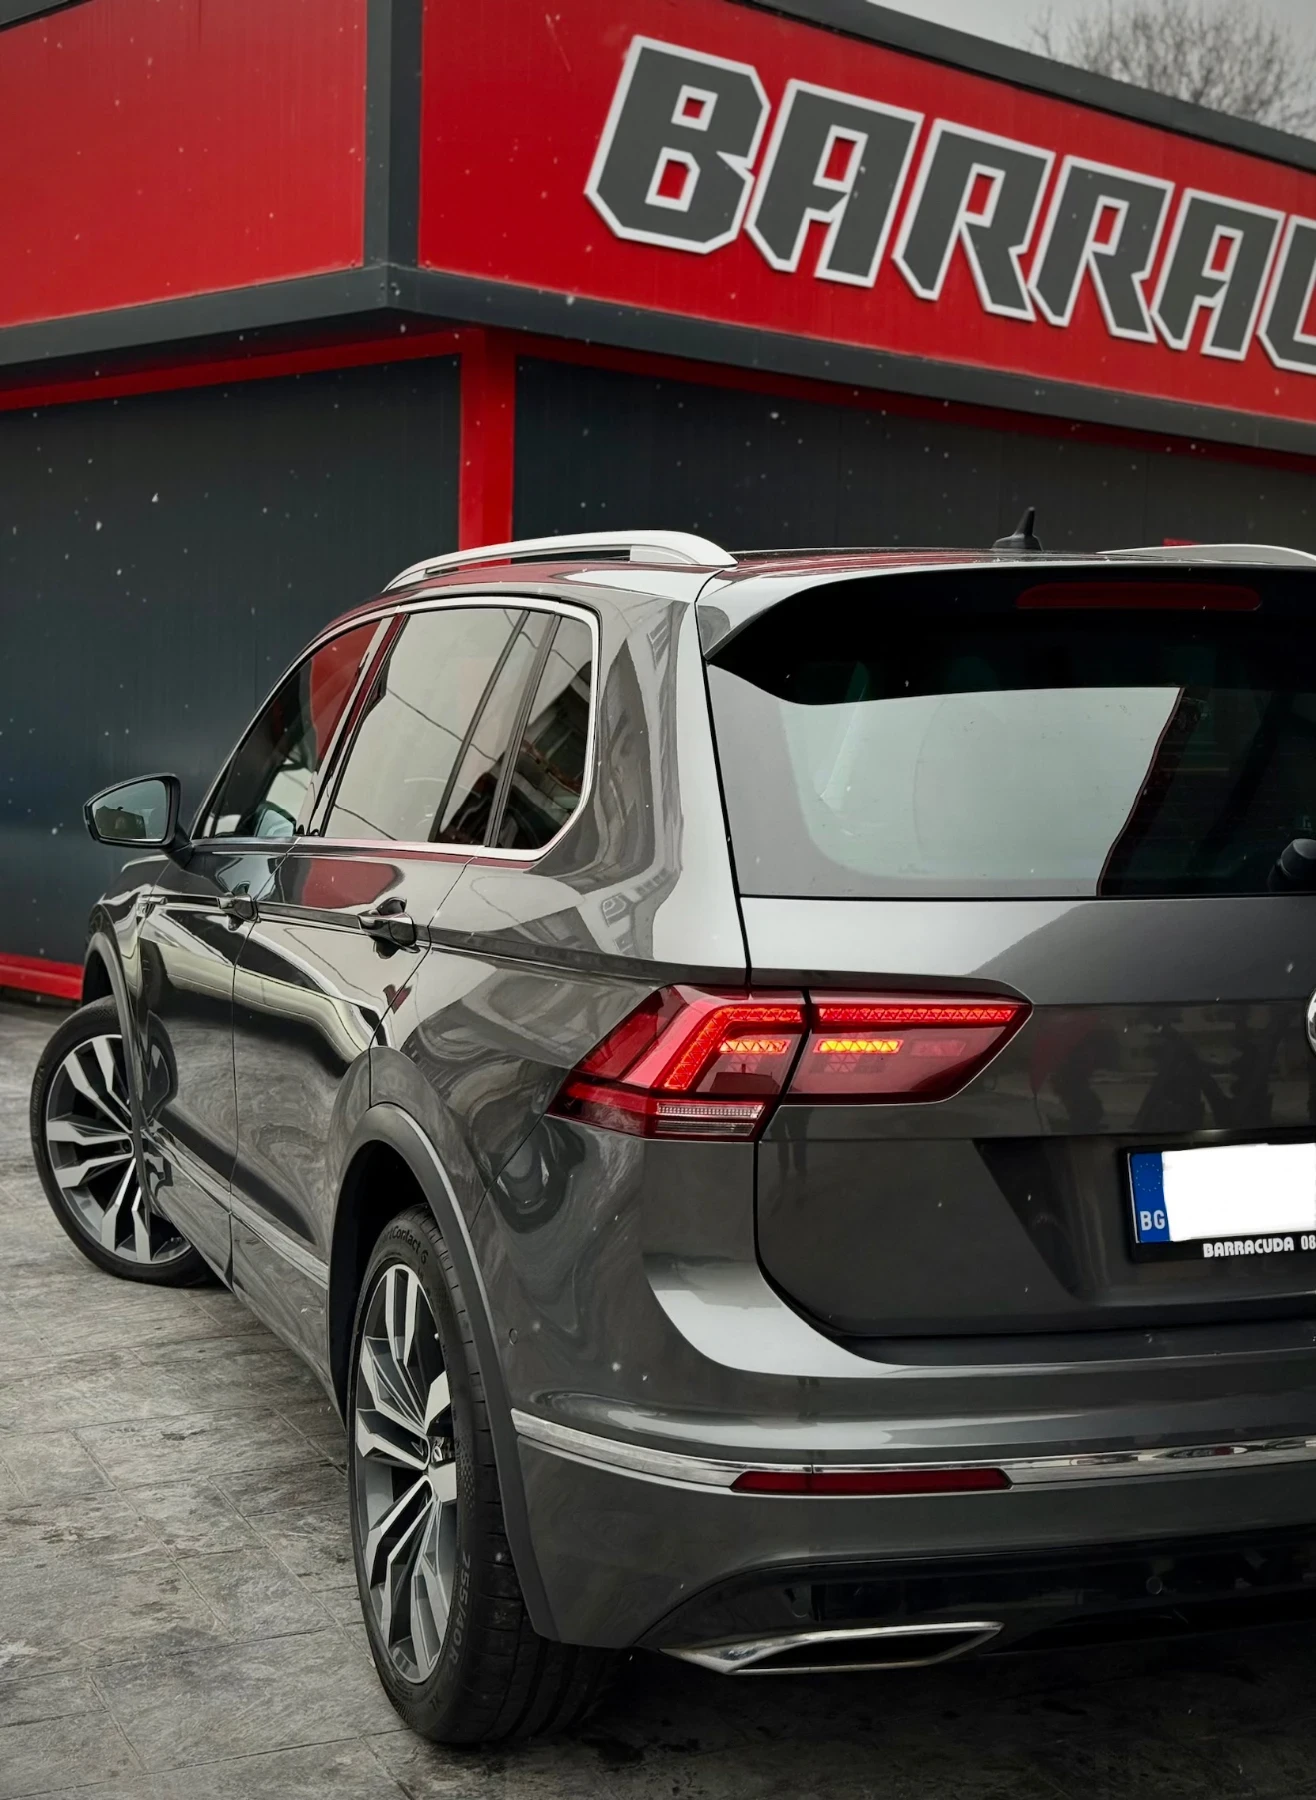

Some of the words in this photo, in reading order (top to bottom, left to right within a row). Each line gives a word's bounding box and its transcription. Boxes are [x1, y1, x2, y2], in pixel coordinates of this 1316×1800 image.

[1139, 1209, 1166, 1231] BG
[1203, 1236, 1295, 1258] BARRACUDA
[1300, 1234, 1316, 1250] 08
